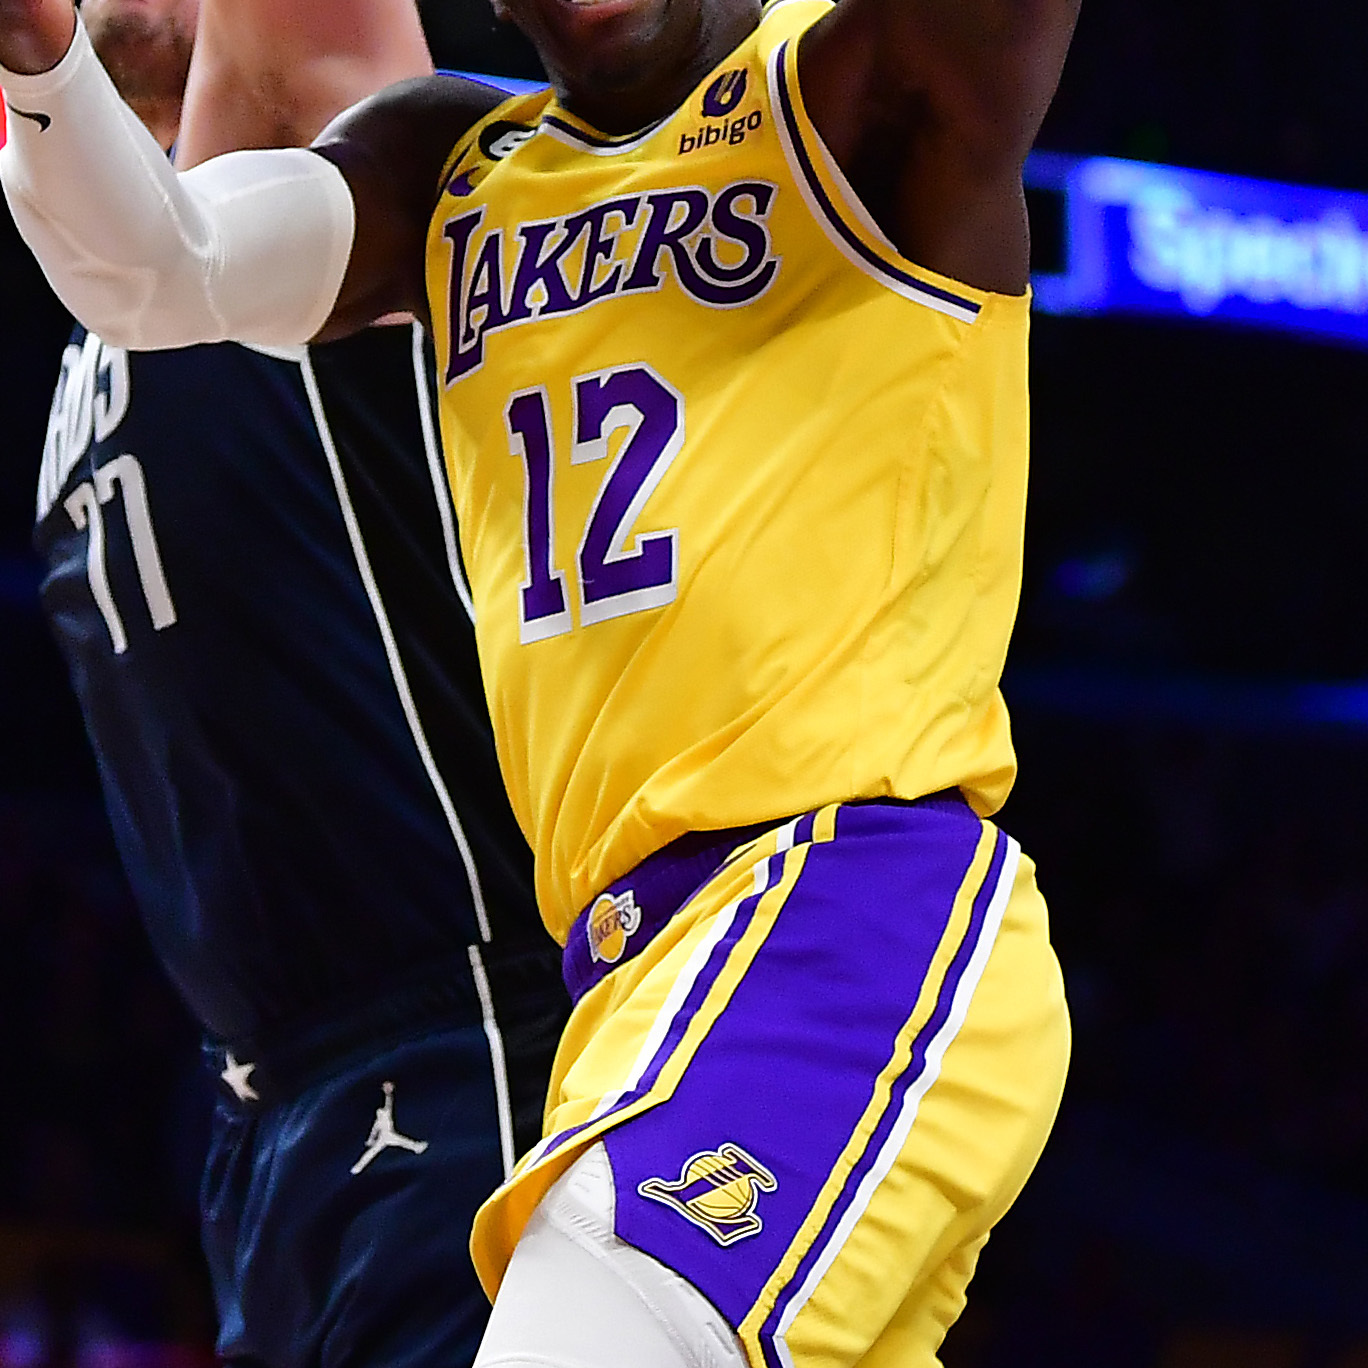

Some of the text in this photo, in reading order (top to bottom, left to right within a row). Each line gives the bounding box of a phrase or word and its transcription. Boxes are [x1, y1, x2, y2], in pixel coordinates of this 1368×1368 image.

[678, 110, 762, 156] bibigo
[444, 179, 782, 390] LAKERS
[63, 453, 178, 654] 77
[503, 361, 687, 646] 12
